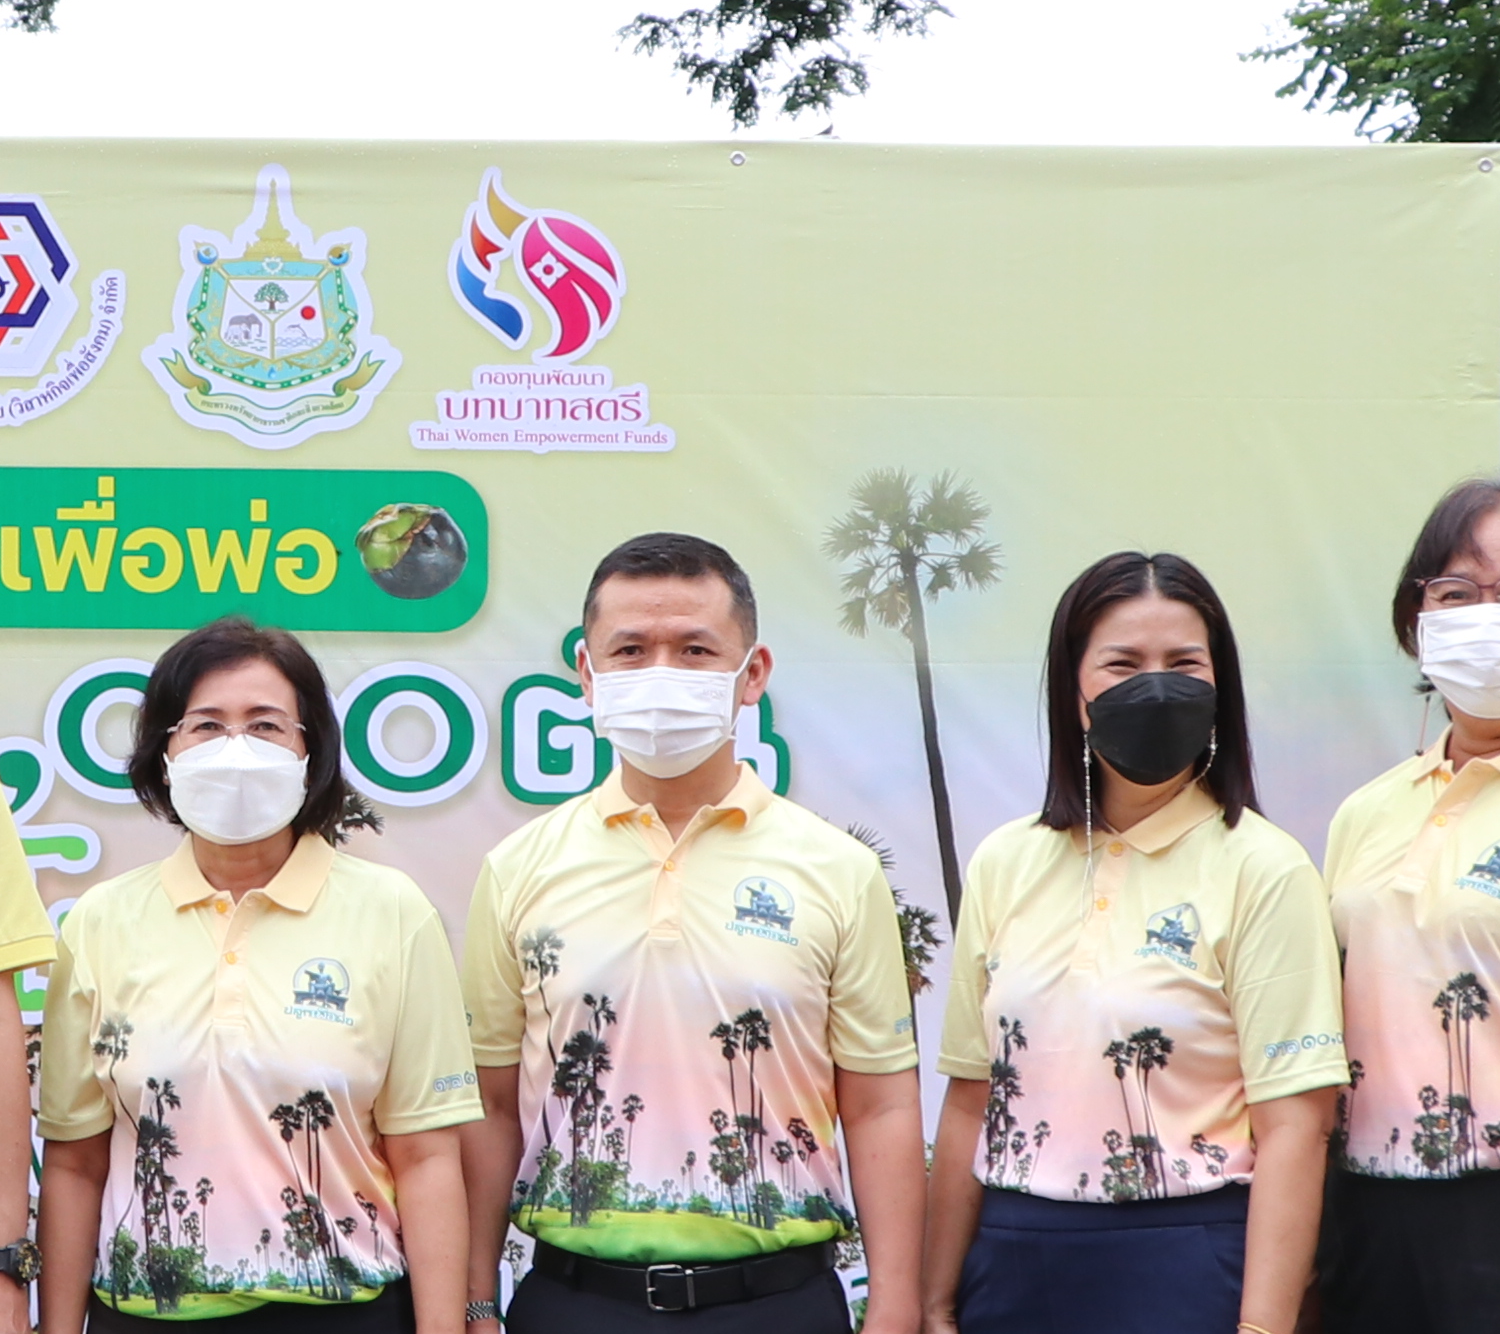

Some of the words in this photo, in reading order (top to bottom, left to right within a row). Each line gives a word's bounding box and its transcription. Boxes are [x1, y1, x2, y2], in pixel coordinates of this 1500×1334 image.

[479, 369, 605, 390] กองทุนพัฒนา
[443, 390, 643, 423] บทบาทสตรี
[416, 427, 450, 443] Thai
[453, 428, 510, 444] Women
[513, 429, 619, 446] Empowerment
[623, 430, 669, 445] Funds
